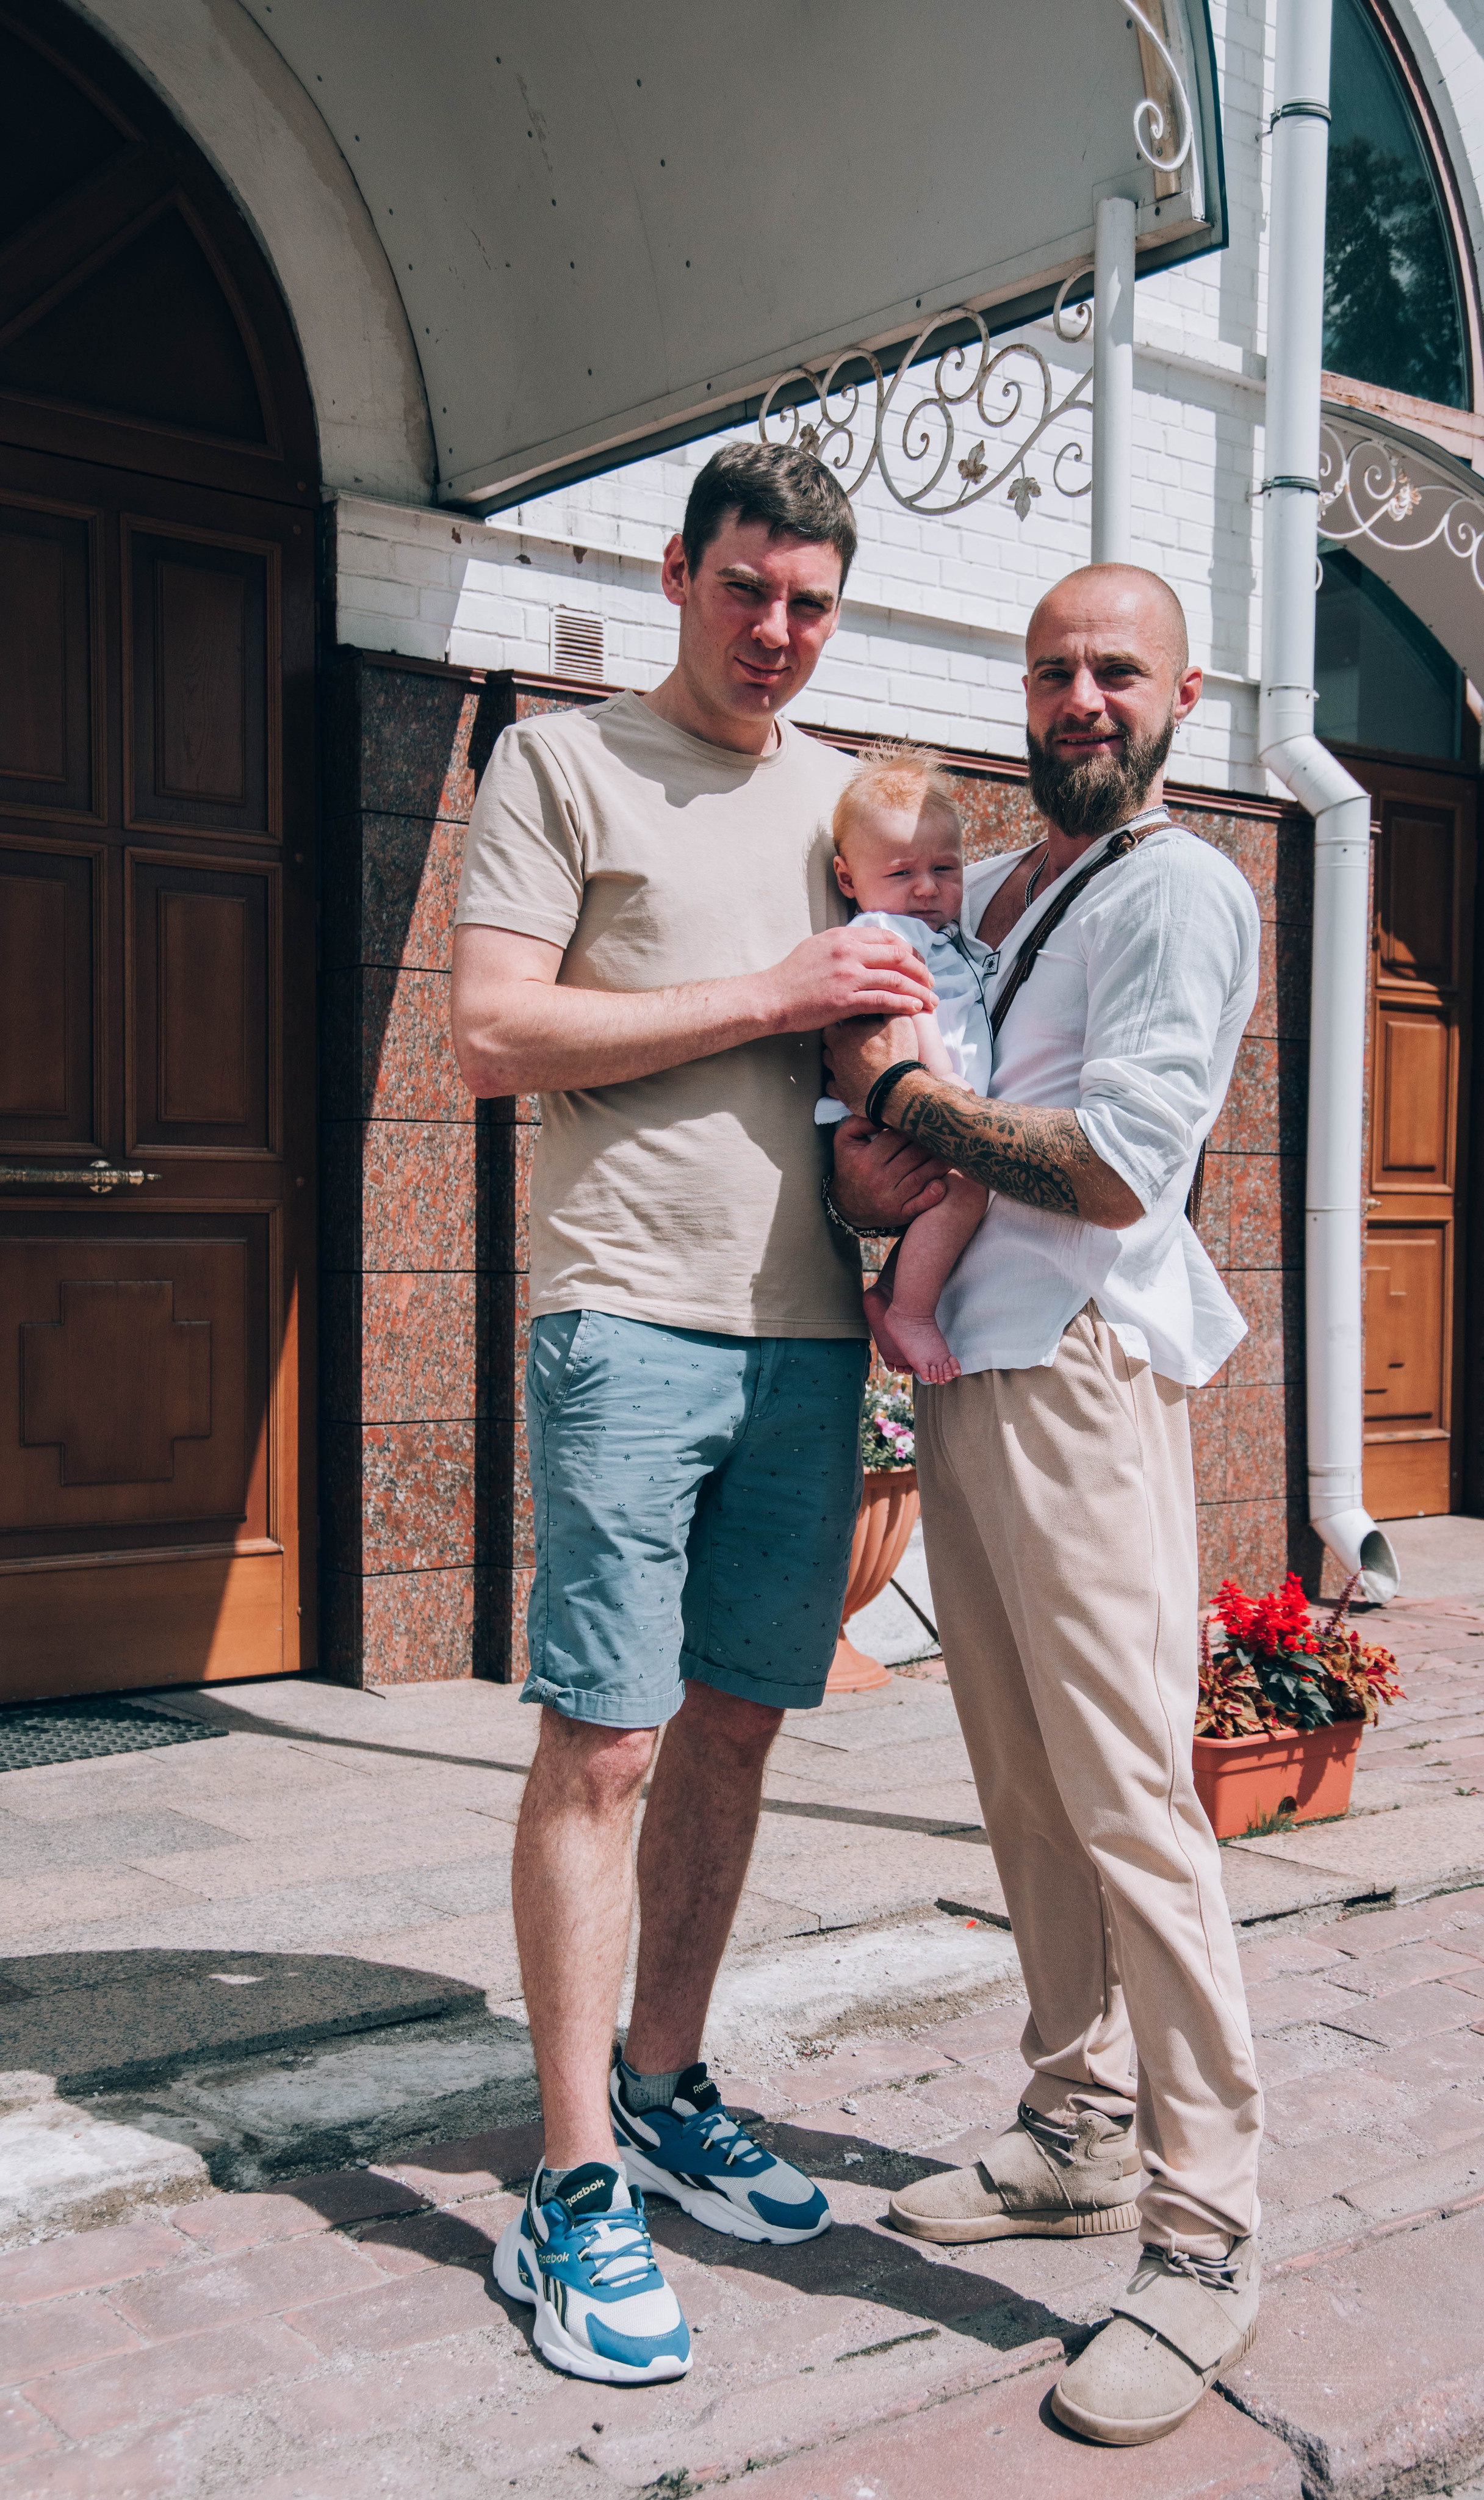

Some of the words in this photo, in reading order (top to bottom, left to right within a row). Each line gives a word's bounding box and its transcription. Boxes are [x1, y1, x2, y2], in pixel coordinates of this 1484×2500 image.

[693, 2078, 713, 2094] Reebo
[565, 2178, 606, 2208] Reebok
[538, 2251, 570, 2265] Reebok
